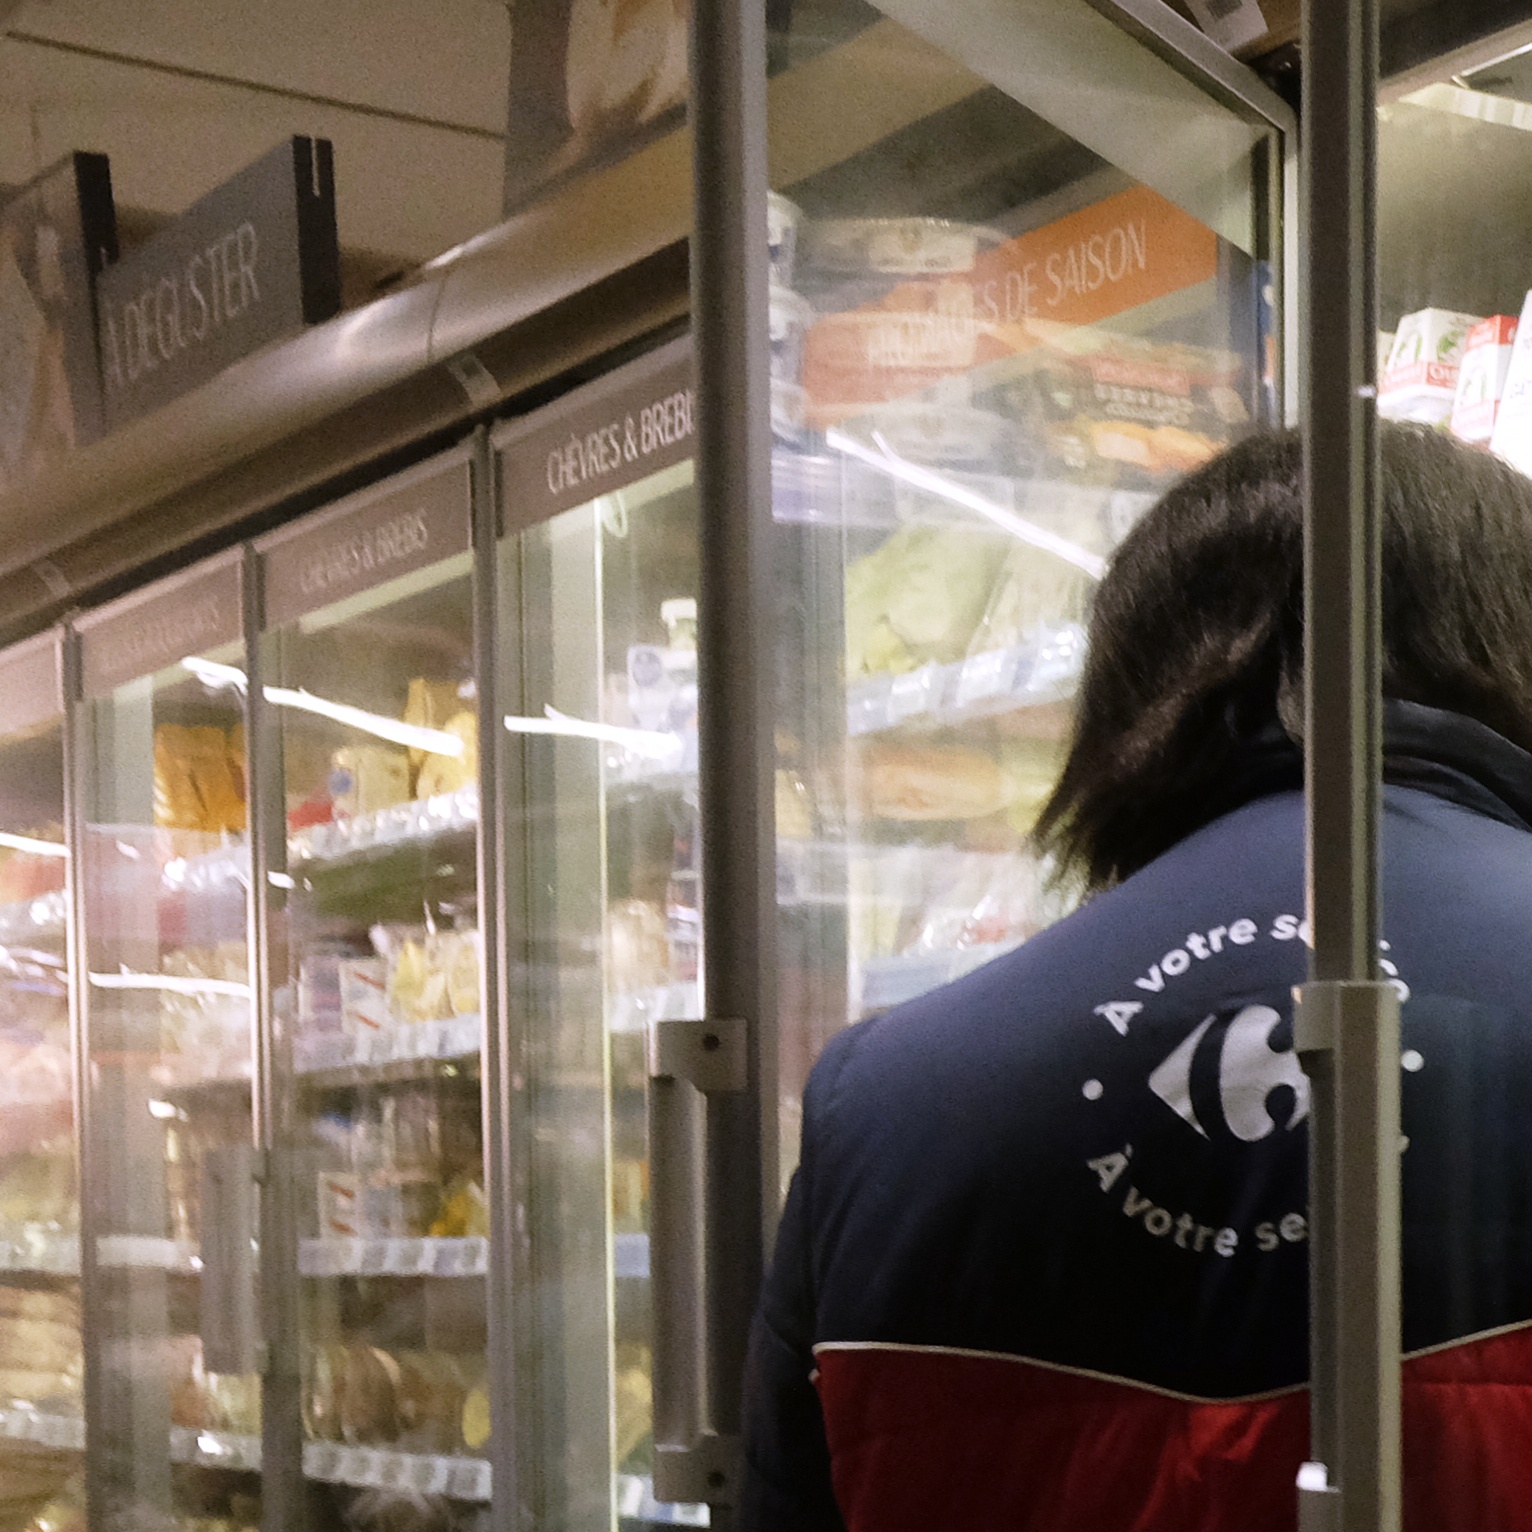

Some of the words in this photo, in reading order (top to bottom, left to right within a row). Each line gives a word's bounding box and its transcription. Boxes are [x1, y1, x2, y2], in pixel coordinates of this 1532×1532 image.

[1046, 219, 1147, 306] SAISON
[624, 414, 638, 462] &
[1134, 917, 1259, 993] votre
[1121, 1185, 1240, 1257] votre
